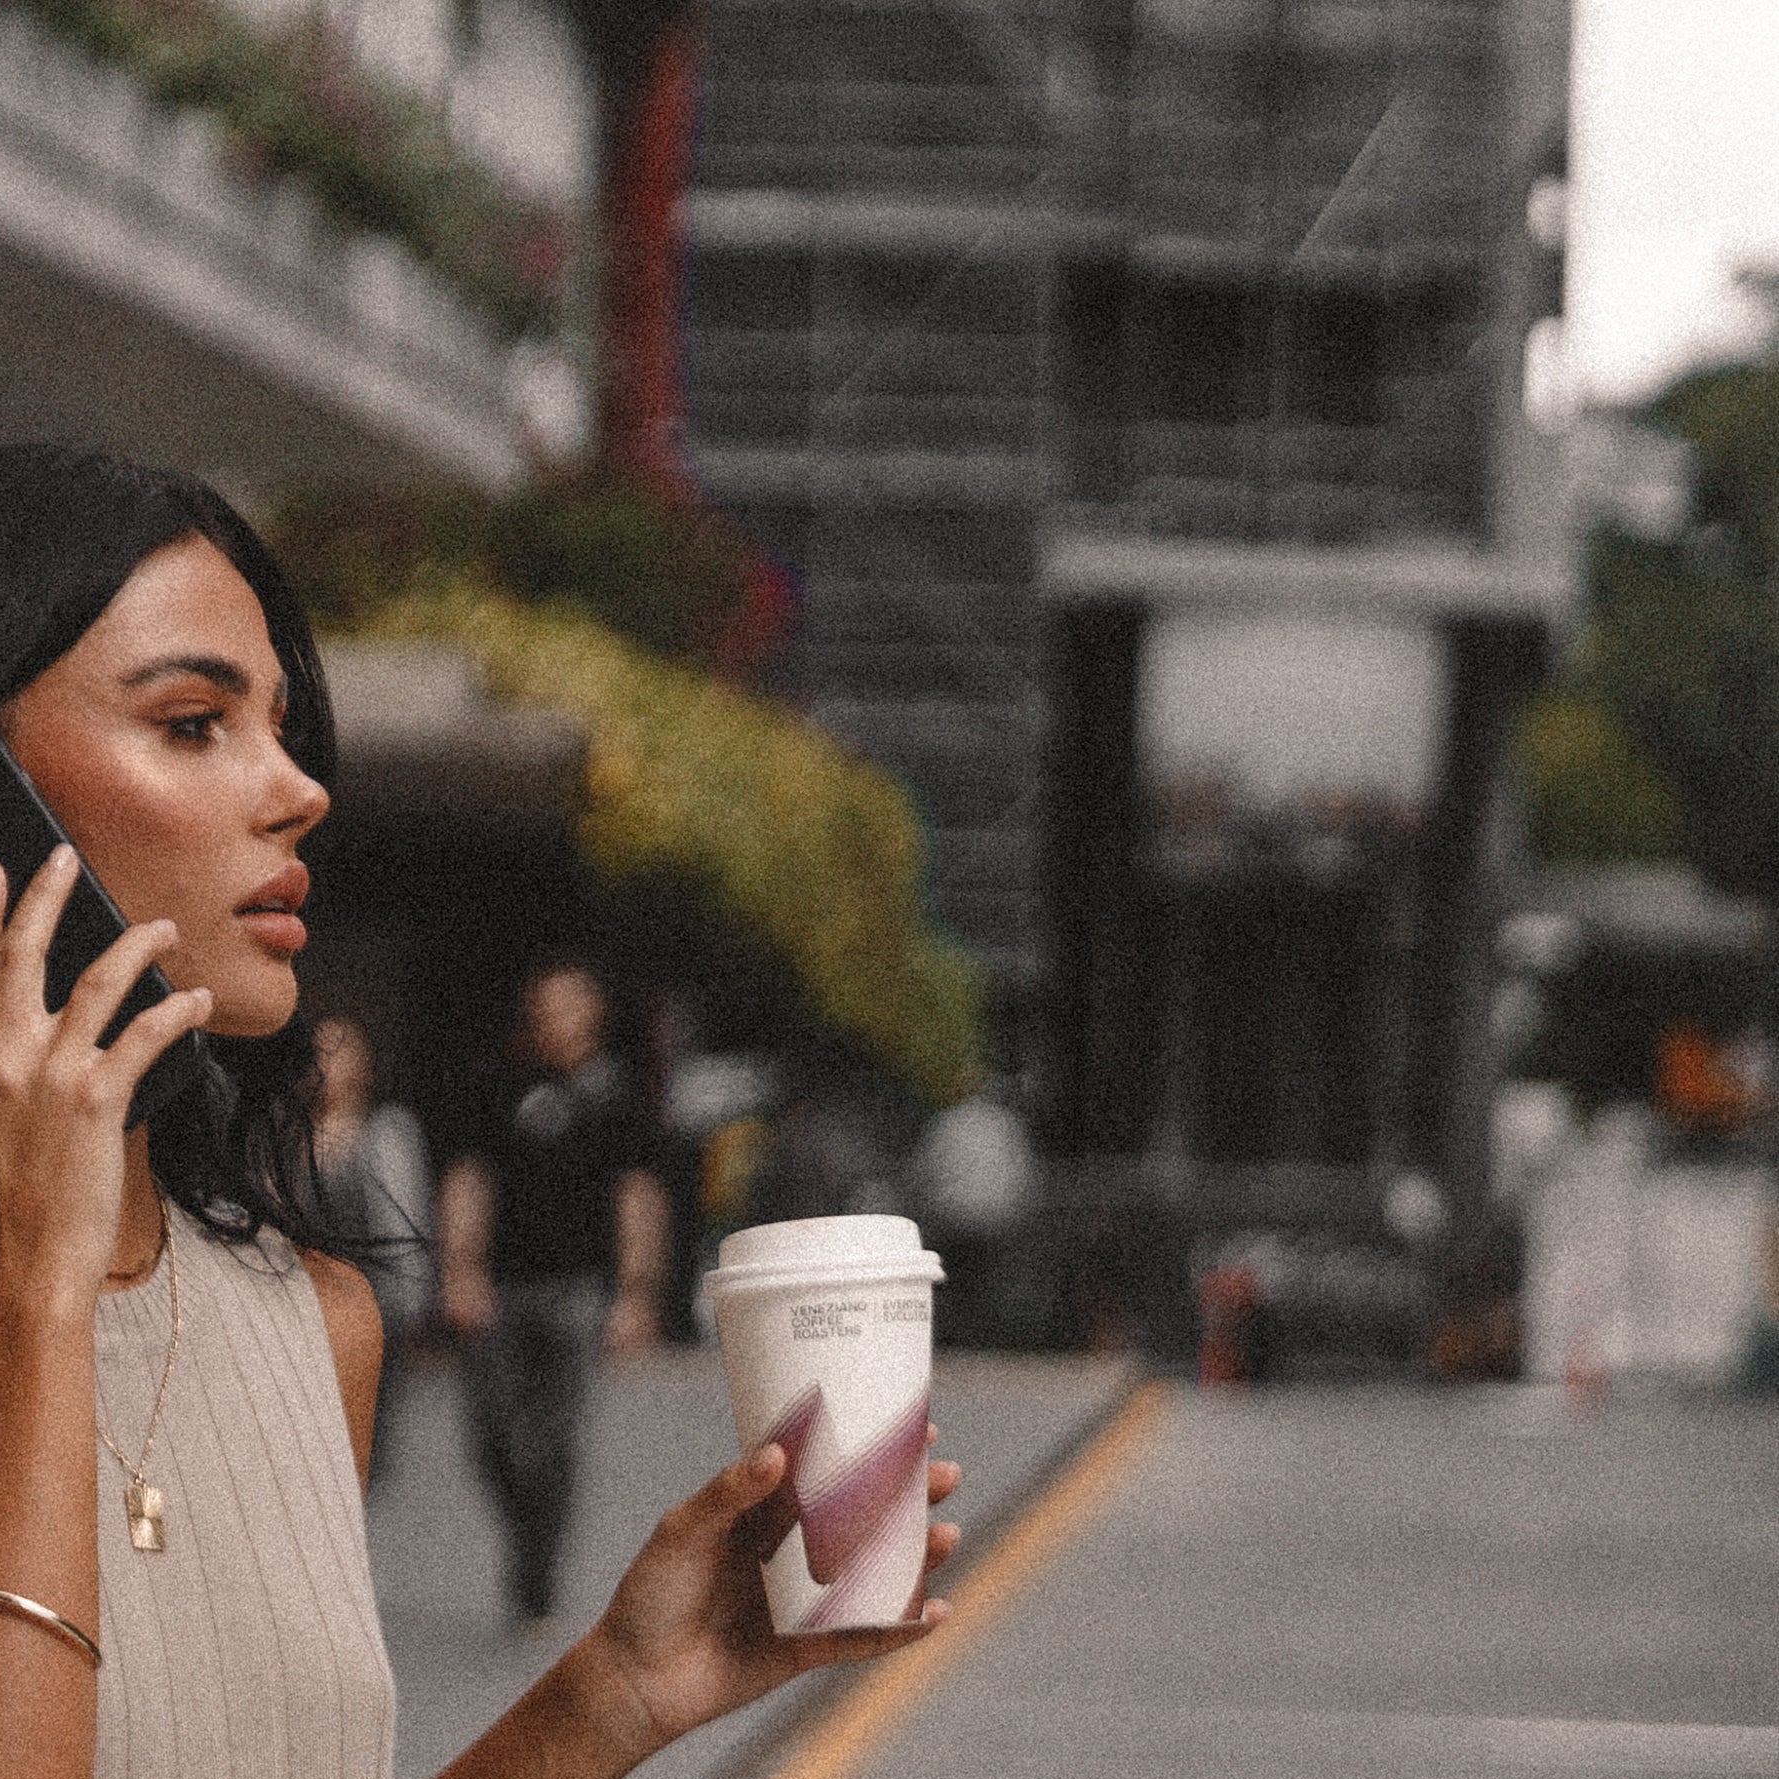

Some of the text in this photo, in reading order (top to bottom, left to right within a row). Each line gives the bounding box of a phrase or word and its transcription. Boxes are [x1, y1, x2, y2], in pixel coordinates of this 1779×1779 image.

[790, 1301, 867, 1316] VENEZIANO
[791, 1314, 843, 1328] COFFEE
[793, 1325, 862, 1340] ROASTERS
